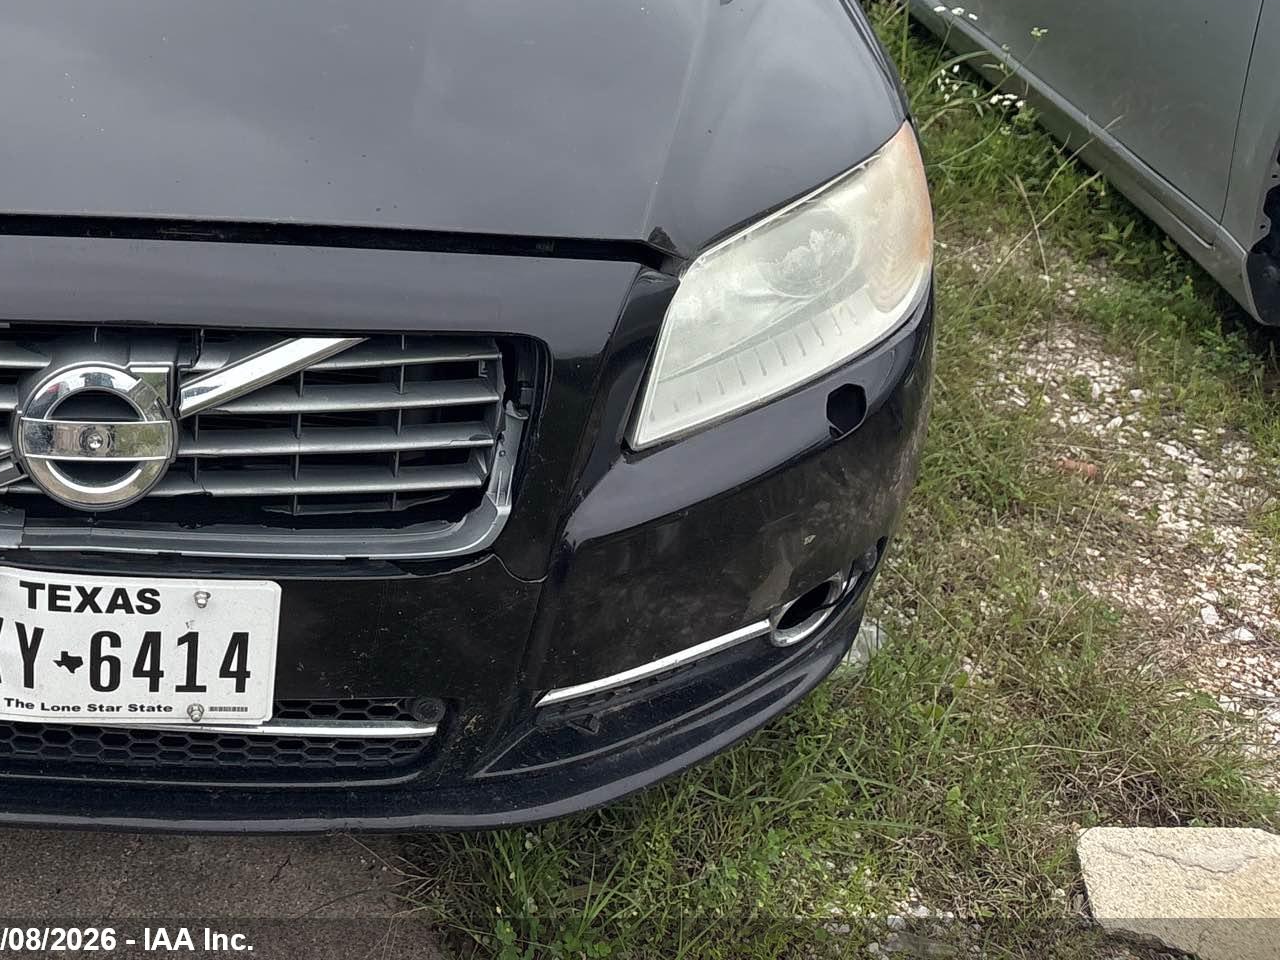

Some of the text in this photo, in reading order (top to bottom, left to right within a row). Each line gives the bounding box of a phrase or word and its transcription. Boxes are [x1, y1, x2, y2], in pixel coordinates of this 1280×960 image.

[19, 580, 161, 615] TEXAS
[88, 630, 252, 693] 6414
[3, 697, 174, 713] The Lone Star State
